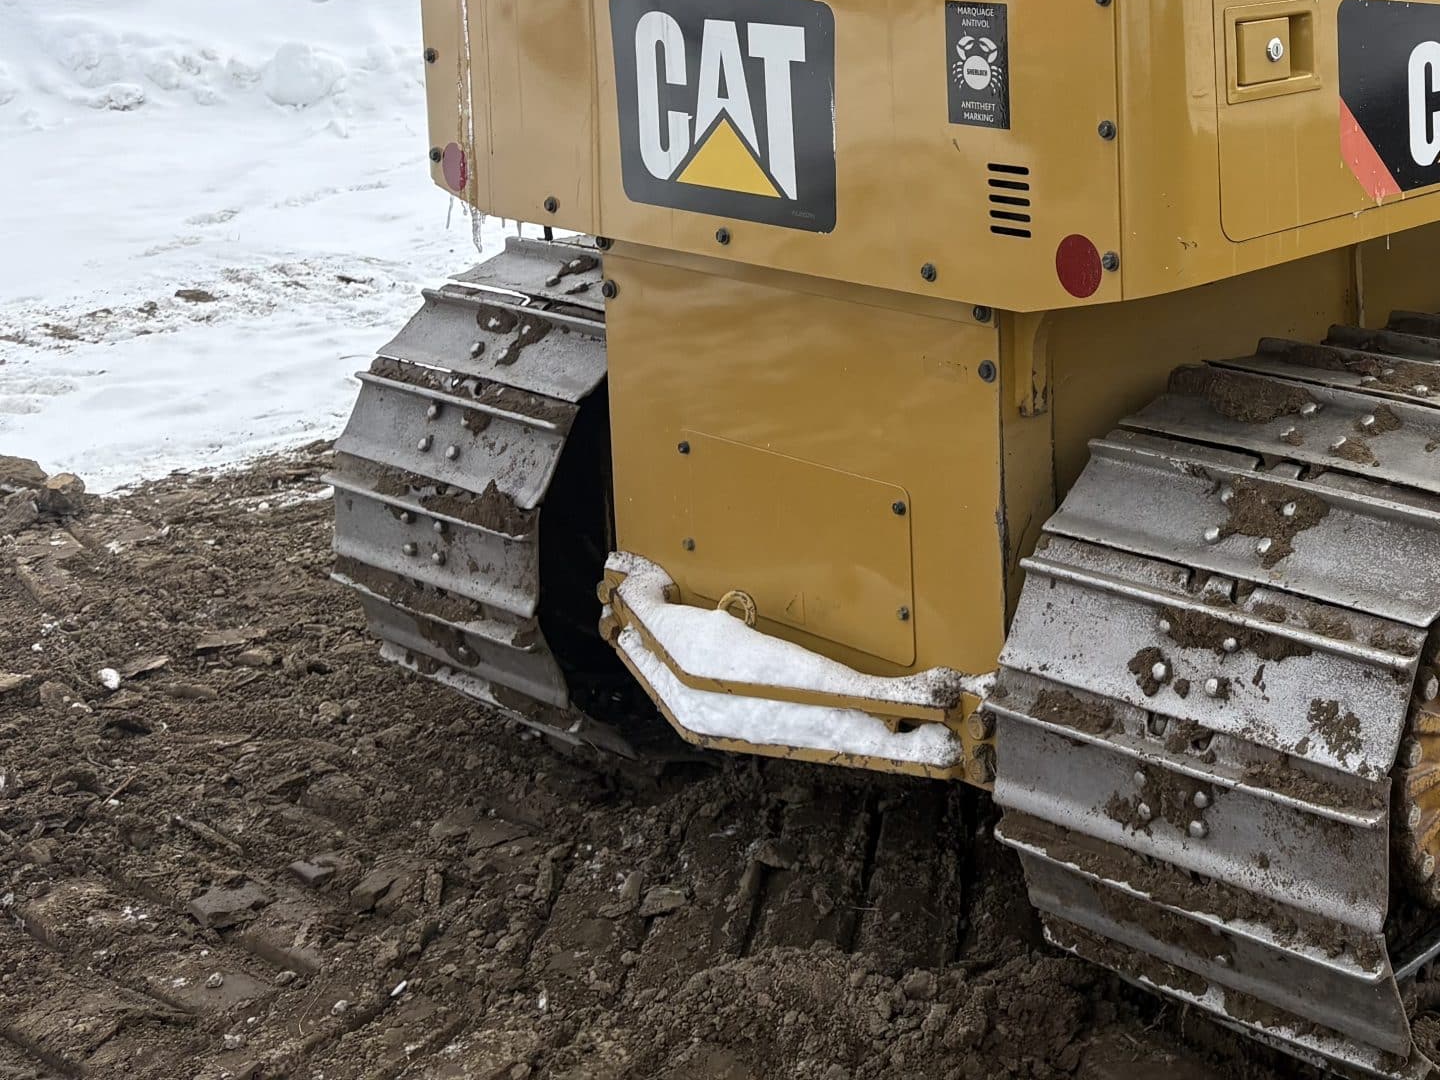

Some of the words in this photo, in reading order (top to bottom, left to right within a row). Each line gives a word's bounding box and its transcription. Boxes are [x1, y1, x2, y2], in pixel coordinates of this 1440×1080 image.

[957, 6, 995, 17] MARQUAGE
[961, 19, 991, 28] ANTIVOL
[966, 68, 988, 76] SHERLOCK
[634, 10, 806, 202] CAT
[961, 100, 996, 112] ANTITHEFT
[963, 112, 995, 123] MARKING
